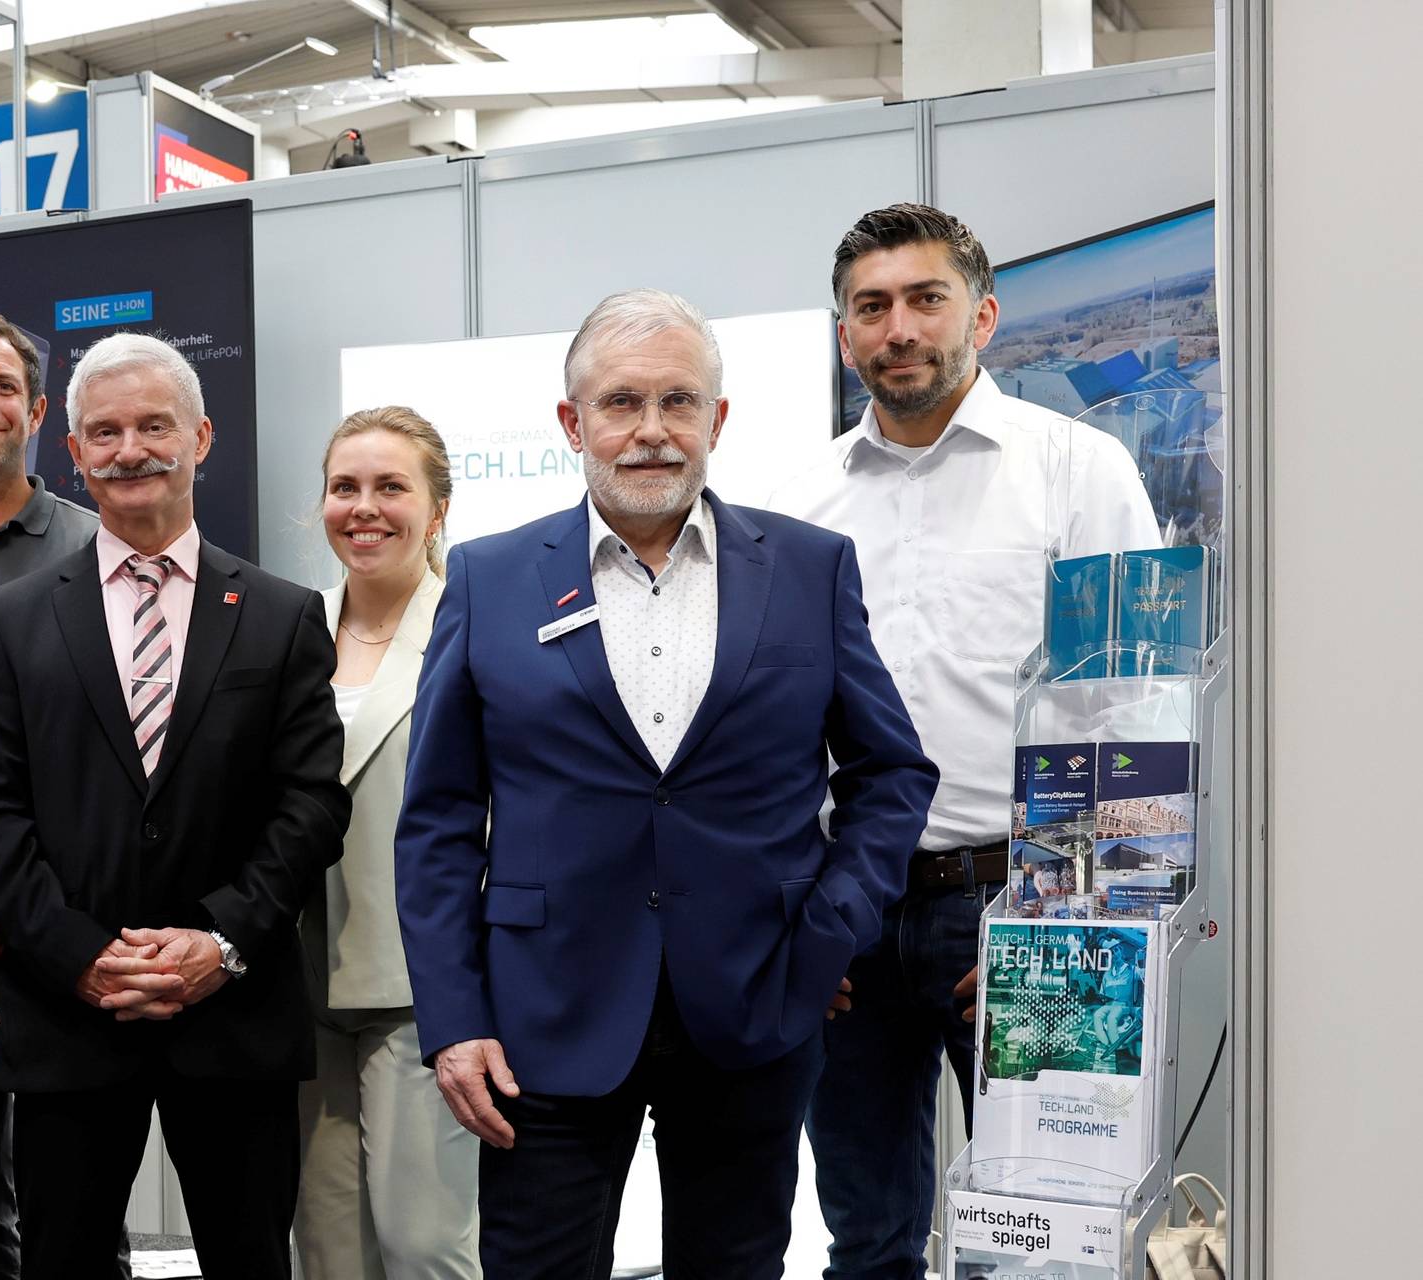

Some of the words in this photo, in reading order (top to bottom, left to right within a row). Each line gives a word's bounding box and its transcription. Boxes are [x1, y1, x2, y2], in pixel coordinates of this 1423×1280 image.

[61, 303, 110, 324] SEINE
[114, 299, 145, 313] LI-ION
[196, 345, 243, 363] (LiFePO4)
[449, 447, 580, 481] ECH.LAN
[990, 933, 1025, 945] DUTCH
[1035, 934, 1081, 946] GERMAN
[988, 945, 1112, 972] TECH.LAND
[1039, 1101, 1094, 1115] TECH.LAND
[1038, 1118, 1118, 1138] PROGRAMME
[956, 1206, 1051, 1231] wirtschafts
[991, 1230, 1050, 1252] spiegel
